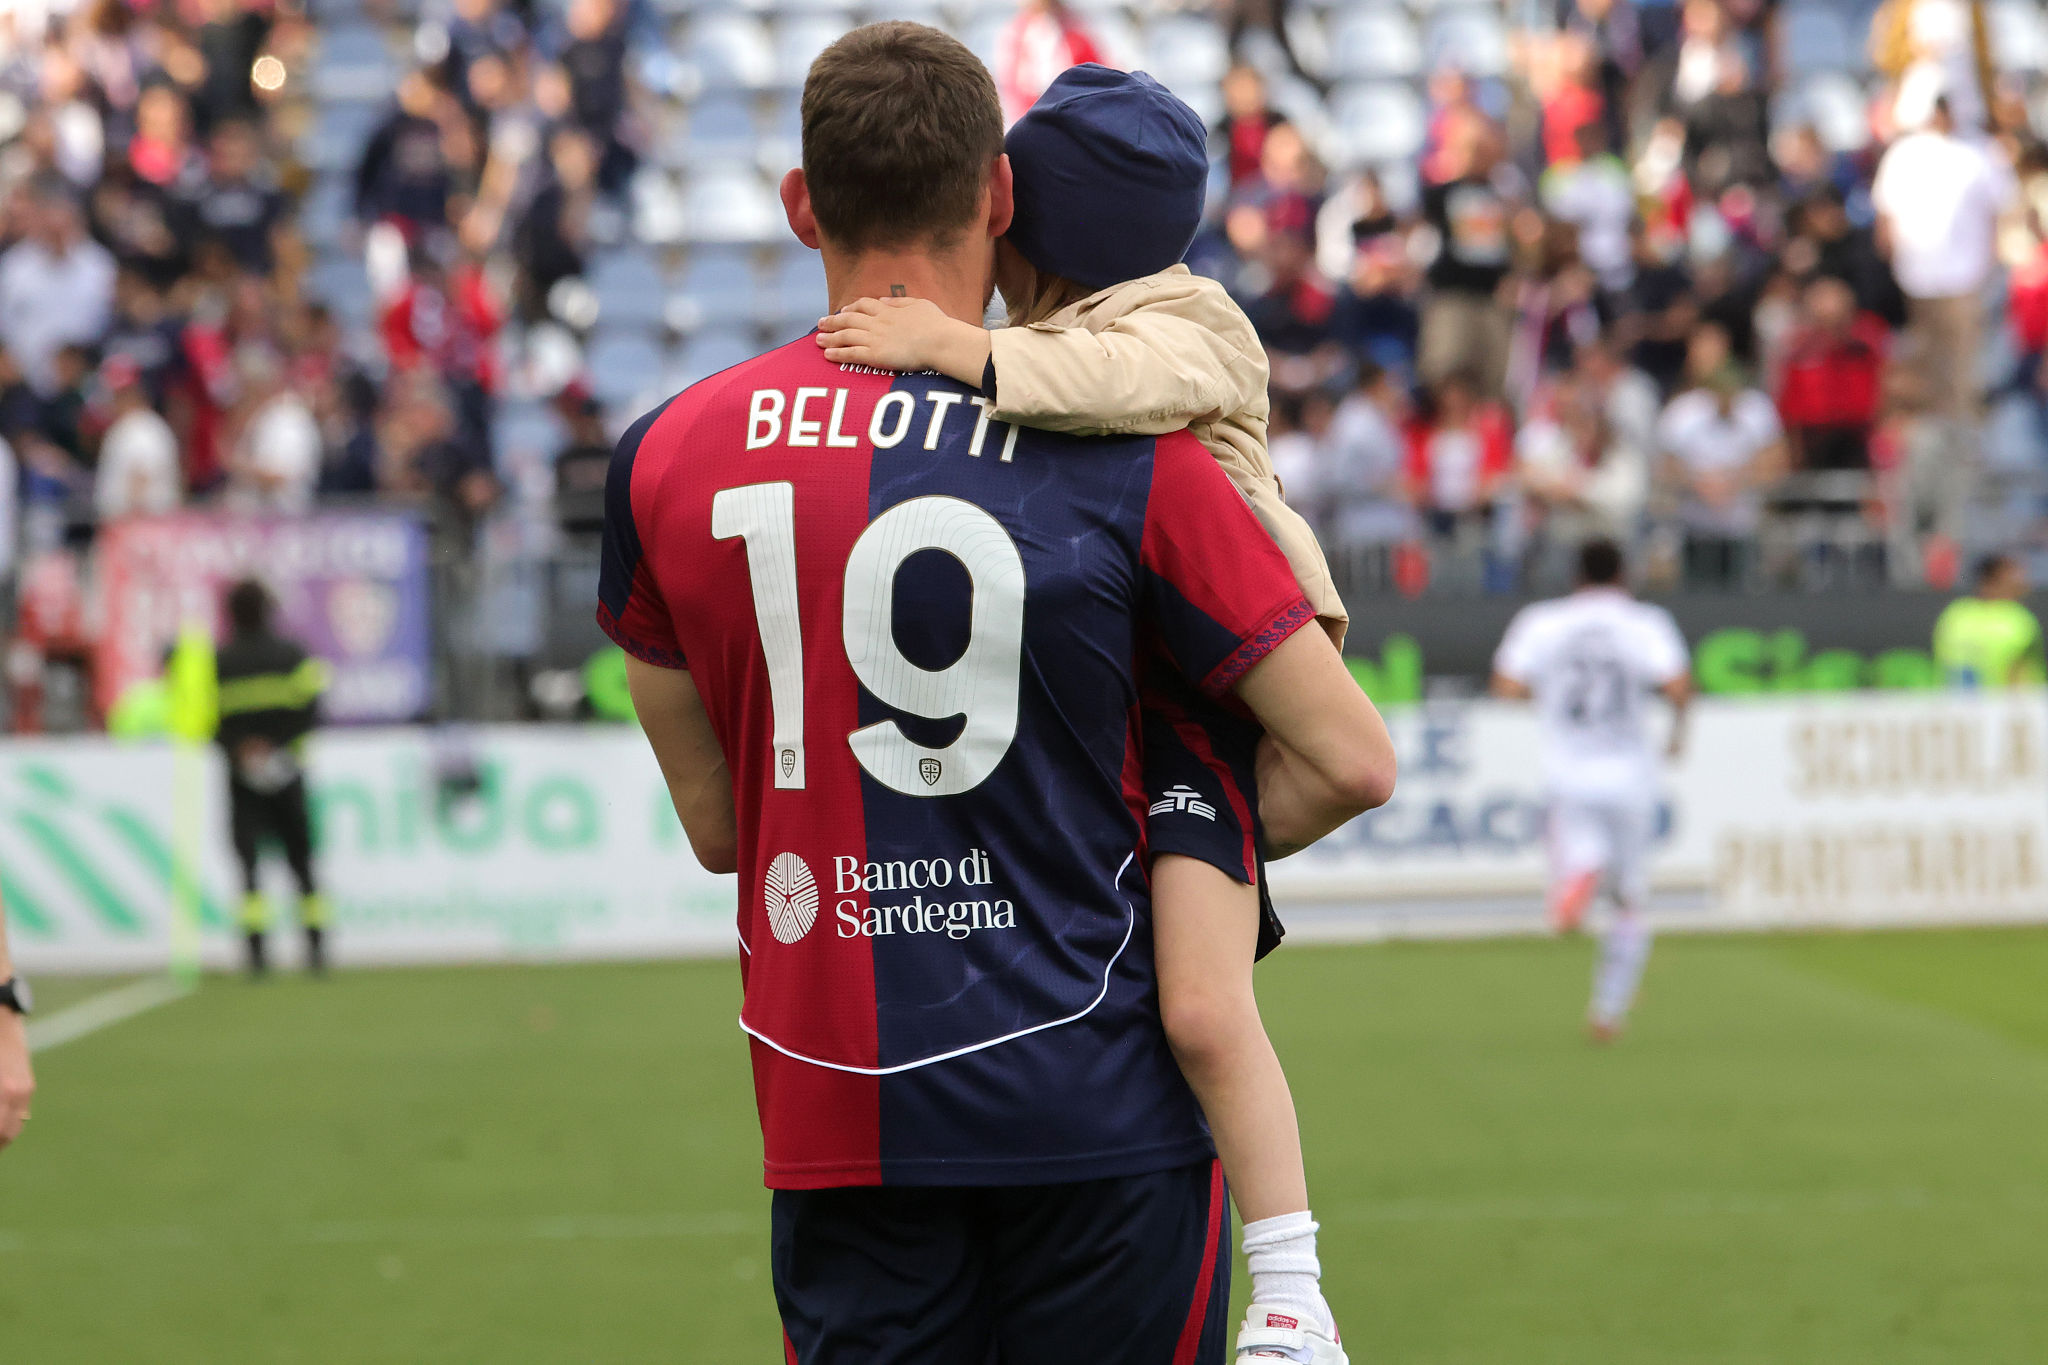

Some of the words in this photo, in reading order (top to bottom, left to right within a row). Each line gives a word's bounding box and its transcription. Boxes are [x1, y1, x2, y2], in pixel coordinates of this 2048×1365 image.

[746, 386, 1020, 463] BELOTTI
[711, 479, 1026, 797] 19
[833, 856, 952, 894] Banco
[958, 849, 993, 886] di
[835, 896, 1016, 940] Sardegna
